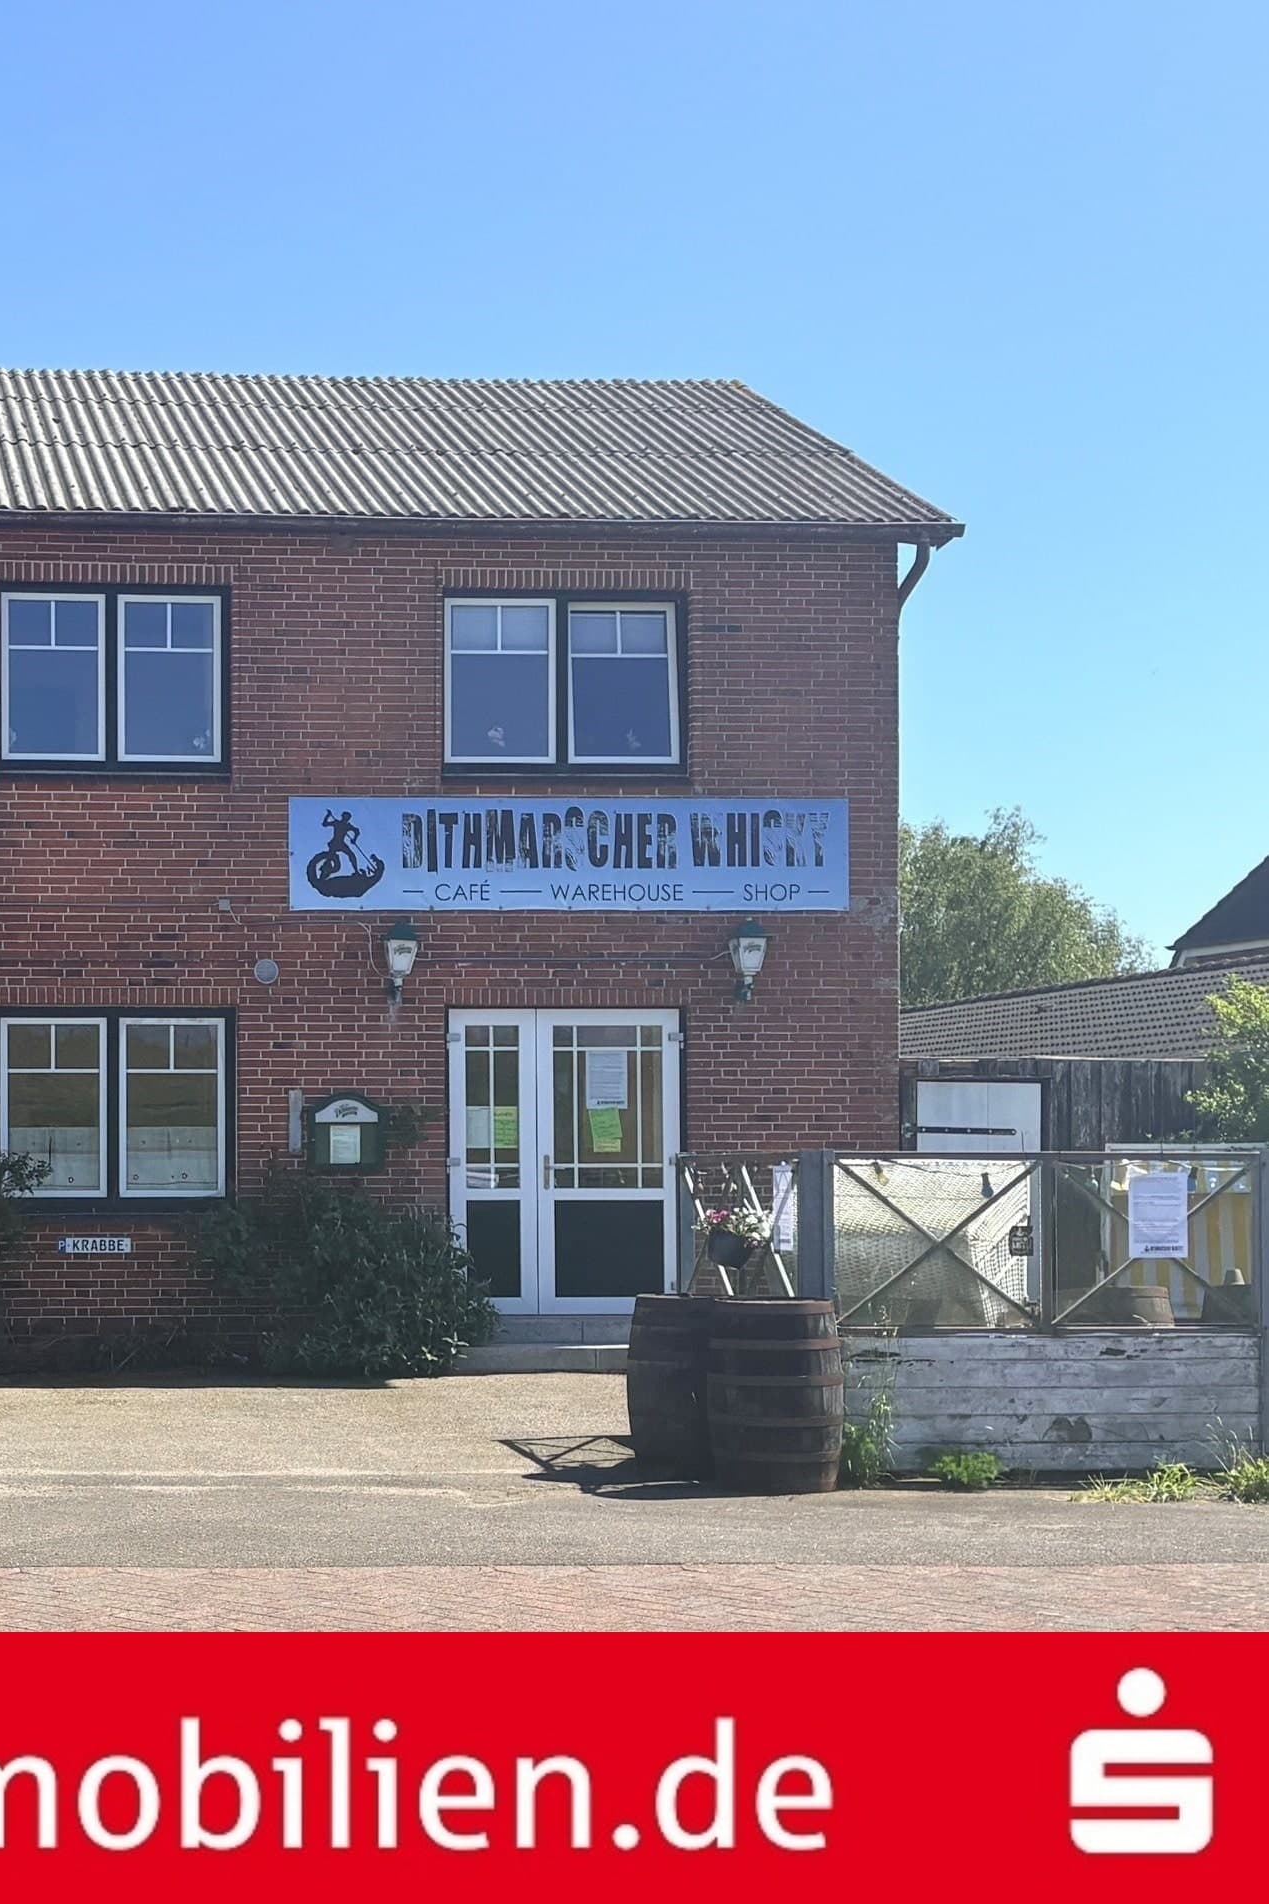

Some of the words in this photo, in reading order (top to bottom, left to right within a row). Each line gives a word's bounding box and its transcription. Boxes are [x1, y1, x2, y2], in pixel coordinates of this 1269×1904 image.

[402, 806, 677, 873] DITHMARSCHER
[691, 808, 830, 868] WHISKY
[434, 879, 491, 901] CAFÉ
[550, 884, 684, 901] WAREHOUSE
[743, 883, 802, 901] SHOP
[73, 1239, 125, 1252] KRABBE
